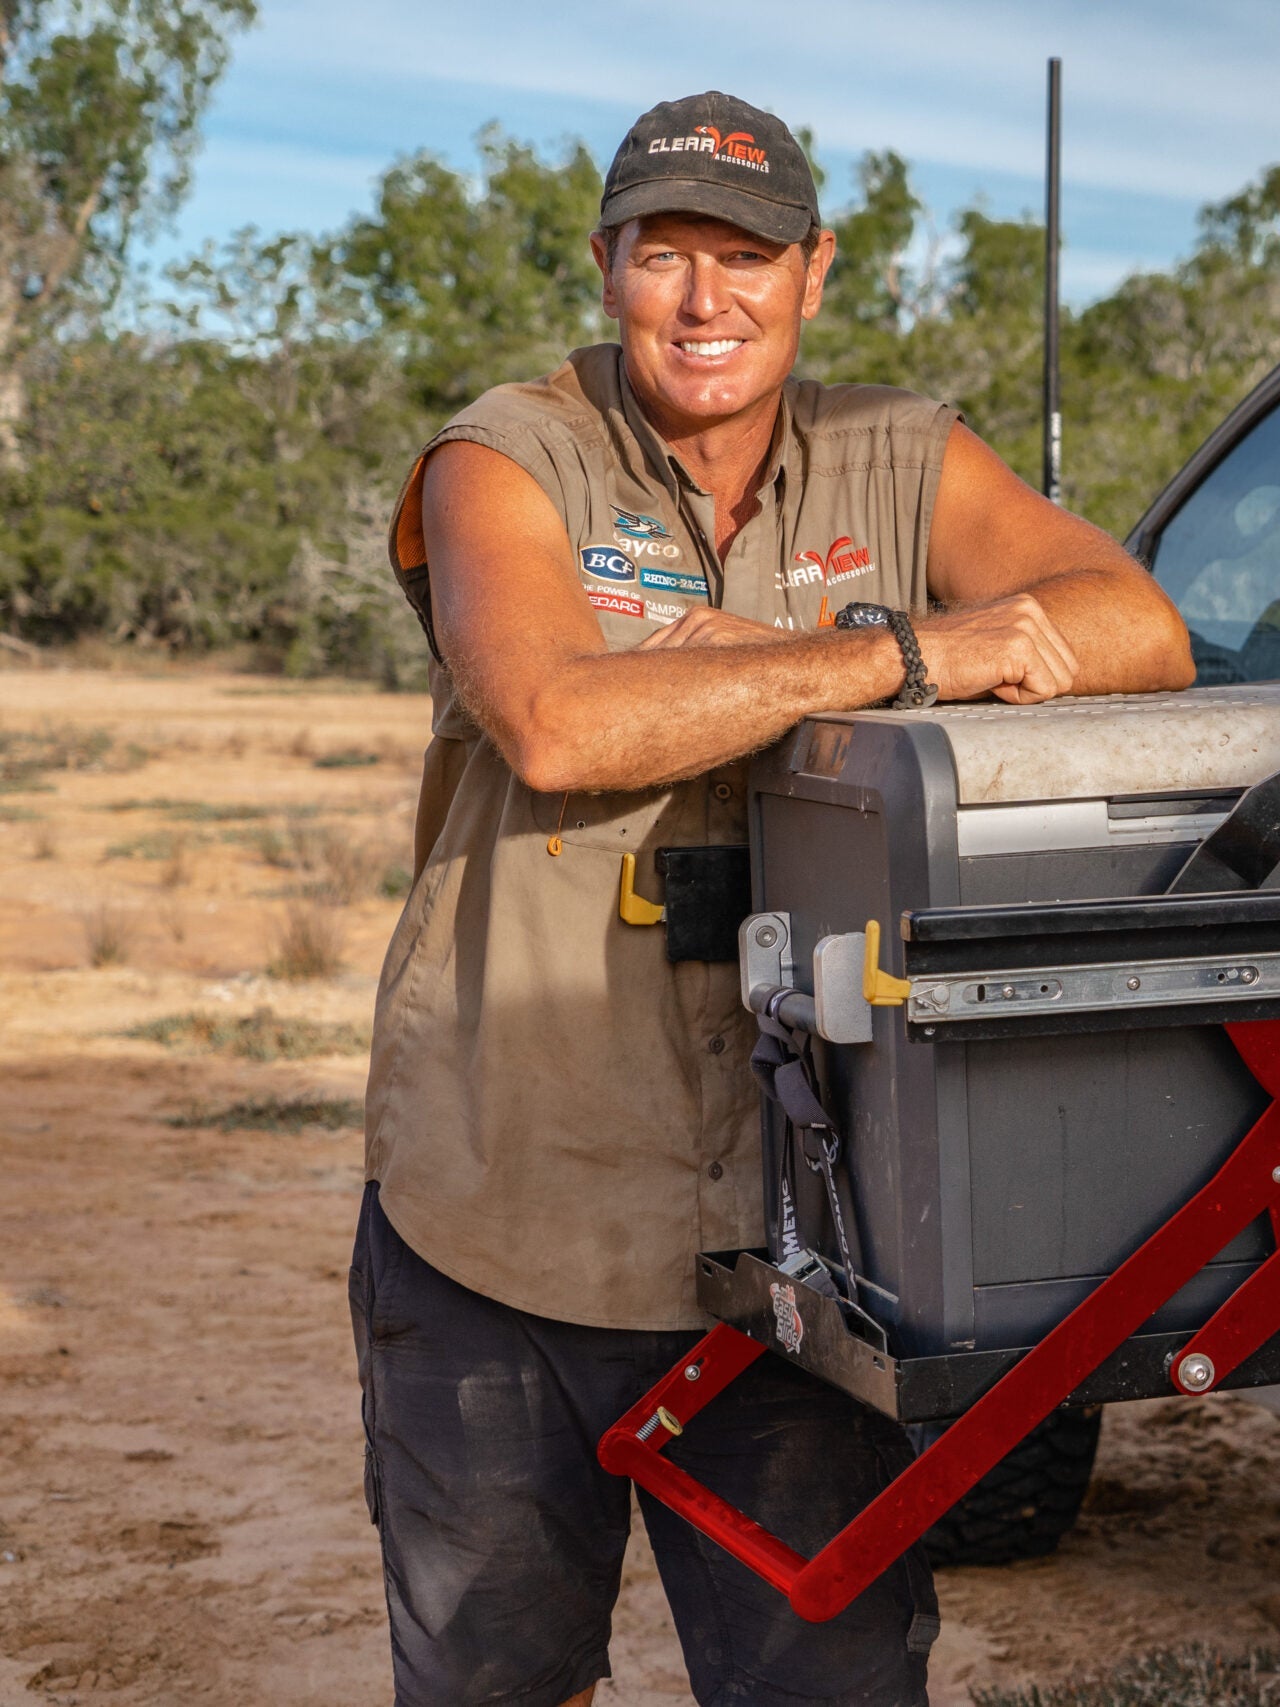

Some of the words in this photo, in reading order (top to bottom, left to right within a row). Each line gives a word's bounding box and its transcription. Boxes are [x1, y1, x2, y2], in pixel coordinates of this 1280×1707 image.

[648, 125, 766, 164] CLEARVIEW
[587, 552, 633, 574] BCF
[582, 583, 594, 591] HE
[597, 585, 629, 598] POWER
[588, 596, 640, 614] EDARC
